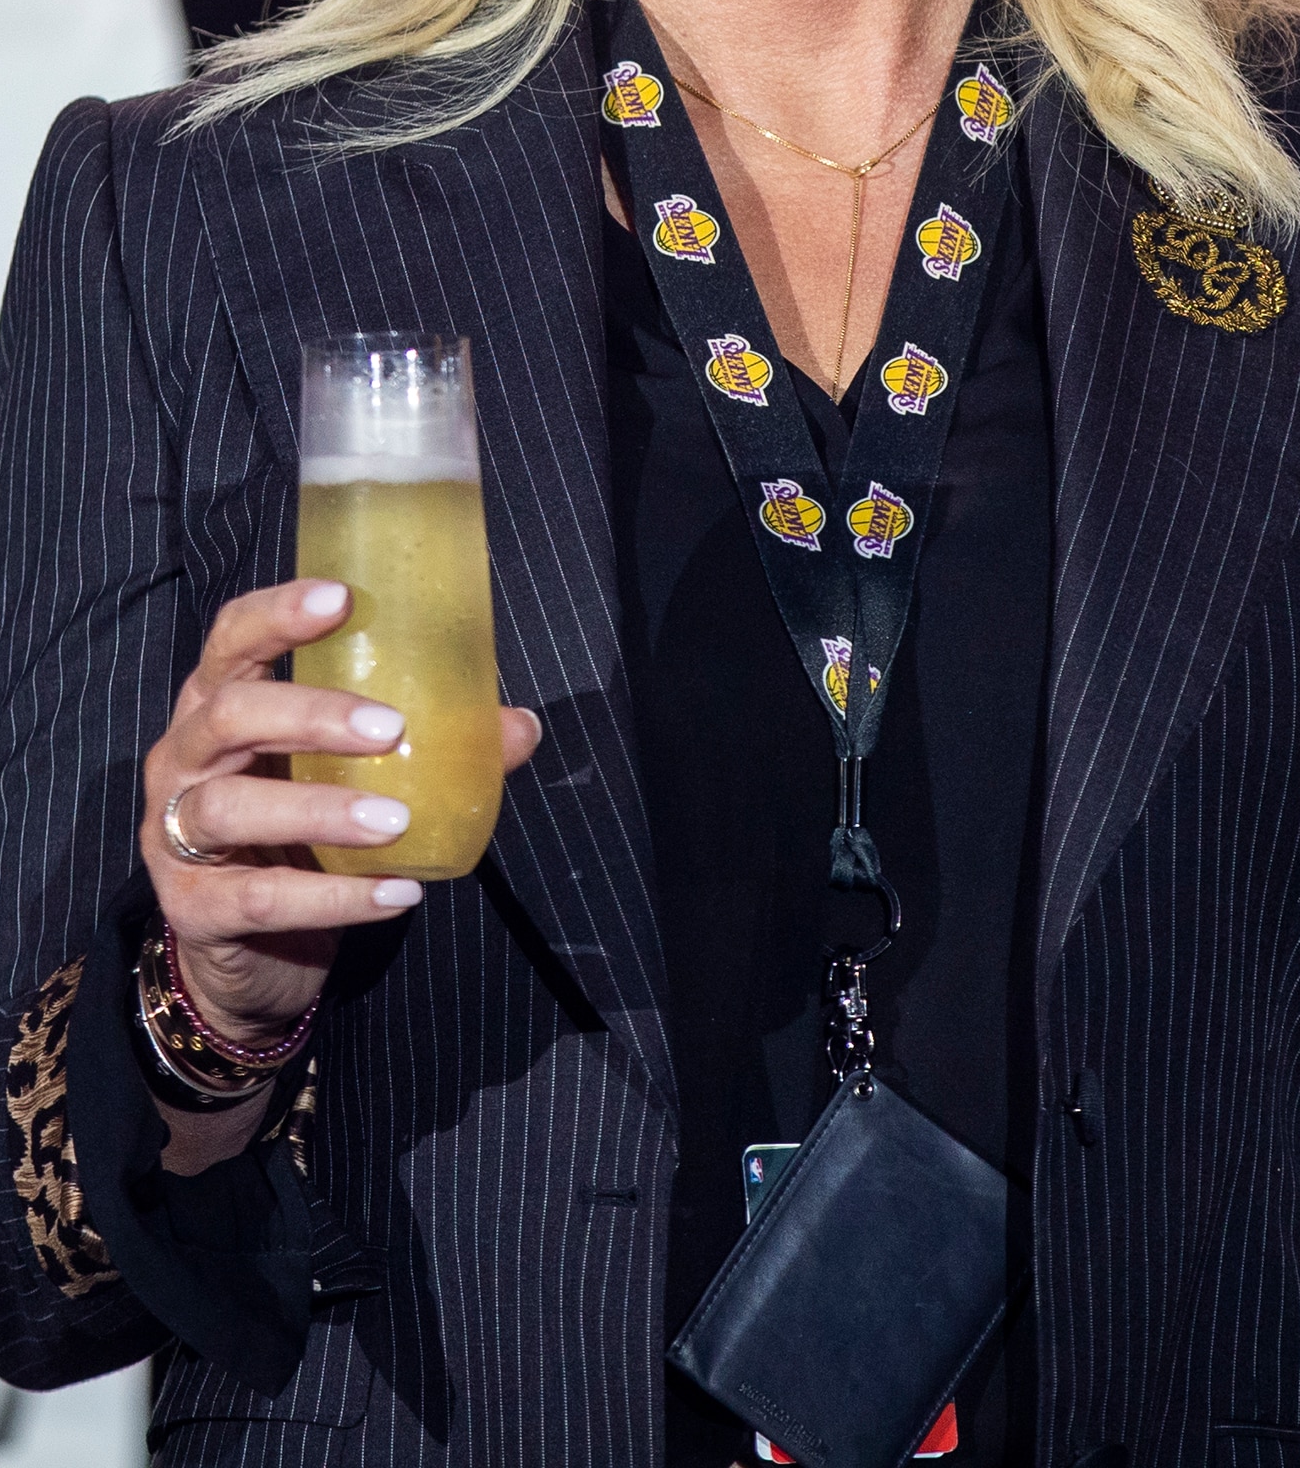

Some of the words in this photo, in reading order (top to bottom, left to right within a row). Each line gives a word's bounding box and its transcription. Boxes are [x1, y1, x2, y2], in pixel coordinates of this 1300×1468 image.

[614, 63, 657, 125] LAKERS
[963, 67, 1005, 139] LAKERS
[666, 196, 713, 262] LAKERS
[925, 206, 970, 276] LAKERS
[719, 335, 765, 404] LAKERS
[891, 345, 936, 412] LAKERS
[772, 481, 819, 549] LAKERS
[857, 484, 902, 556] LAKERS
